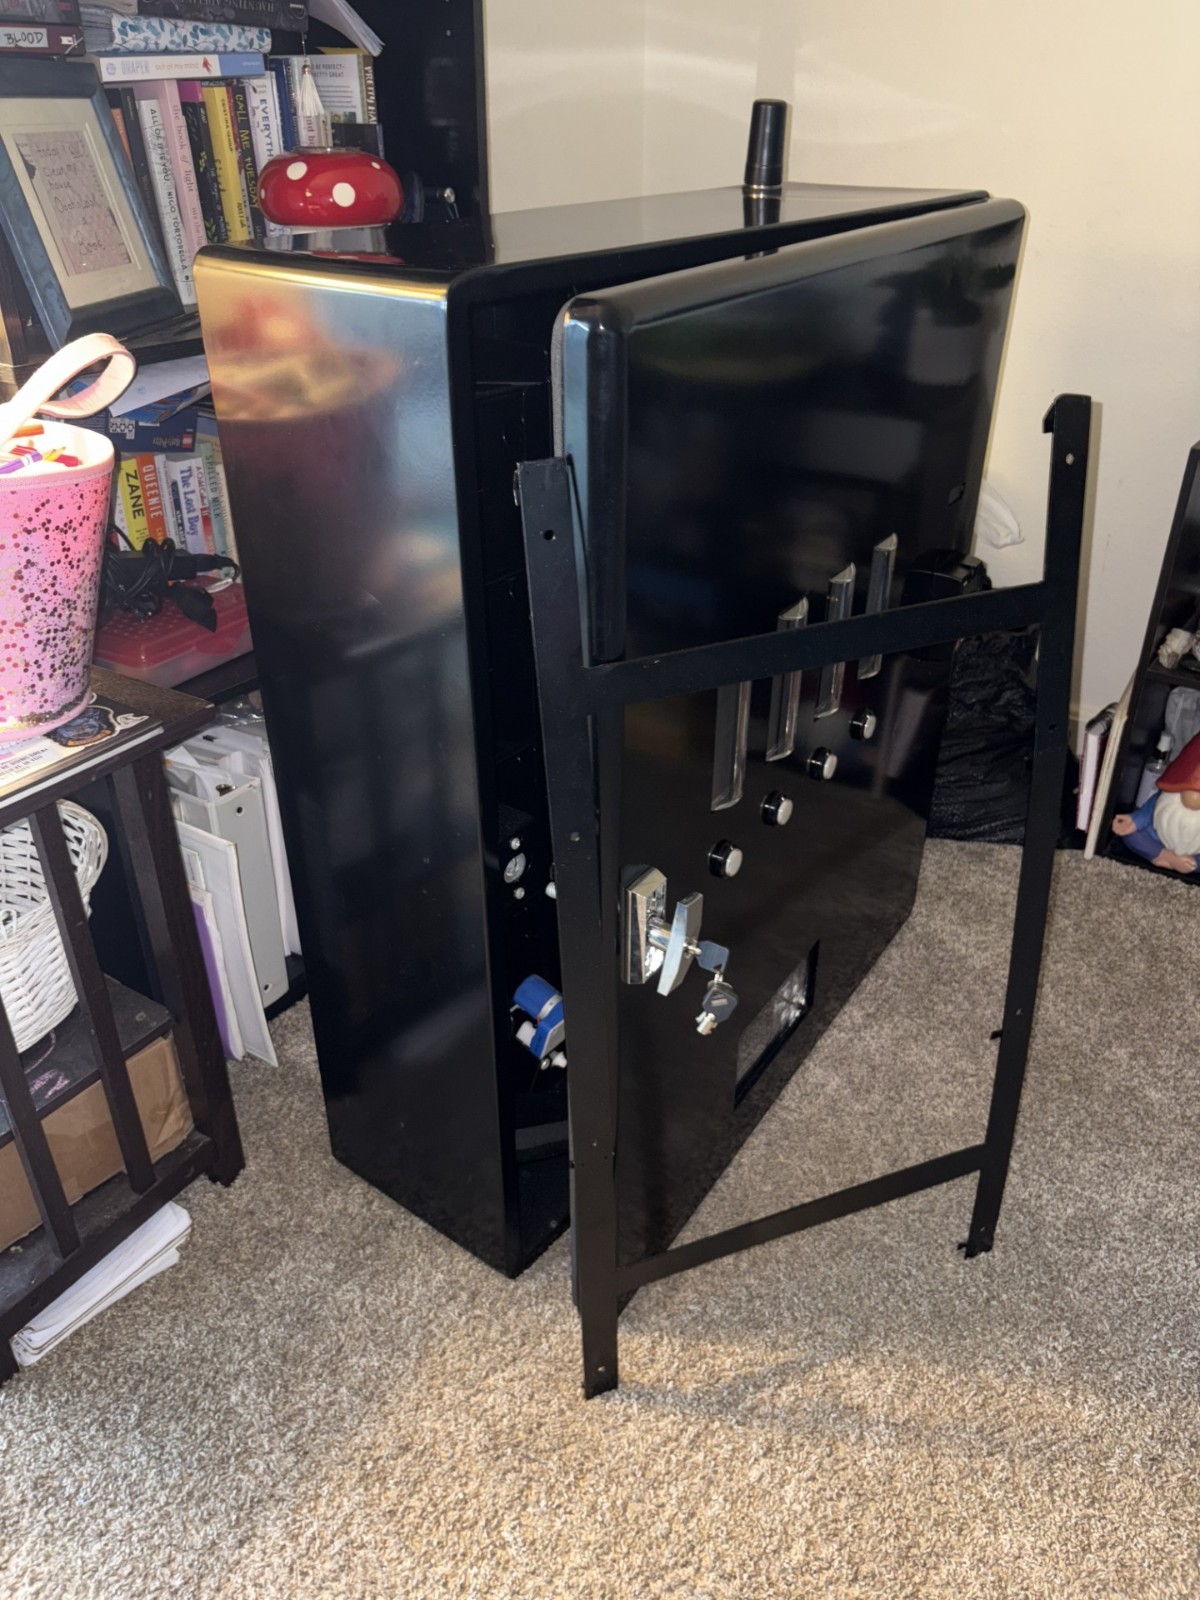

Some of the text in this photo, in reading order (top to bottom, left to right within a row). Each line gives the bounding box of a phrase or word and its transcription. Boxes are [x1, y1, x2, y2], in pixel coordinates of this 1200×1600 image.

[4, 31, 44, 45] BLOOD
[235, 94, 248, 123] CALL
[260, 99, 275, 159] EVERYTH
[150, 108, 159, 126] ALL
[167, 191, 176, 213] NICO
[239, 129, 250, 150] ME
[183, 170, 194, 192] light
[126, 469, 145, 520] ZANE
[142, 464, 162, 519] QUEENIE
[180, 465, 200, 536] The Lost Boy
[205, 455, 221, 519] SPILLED MILK
